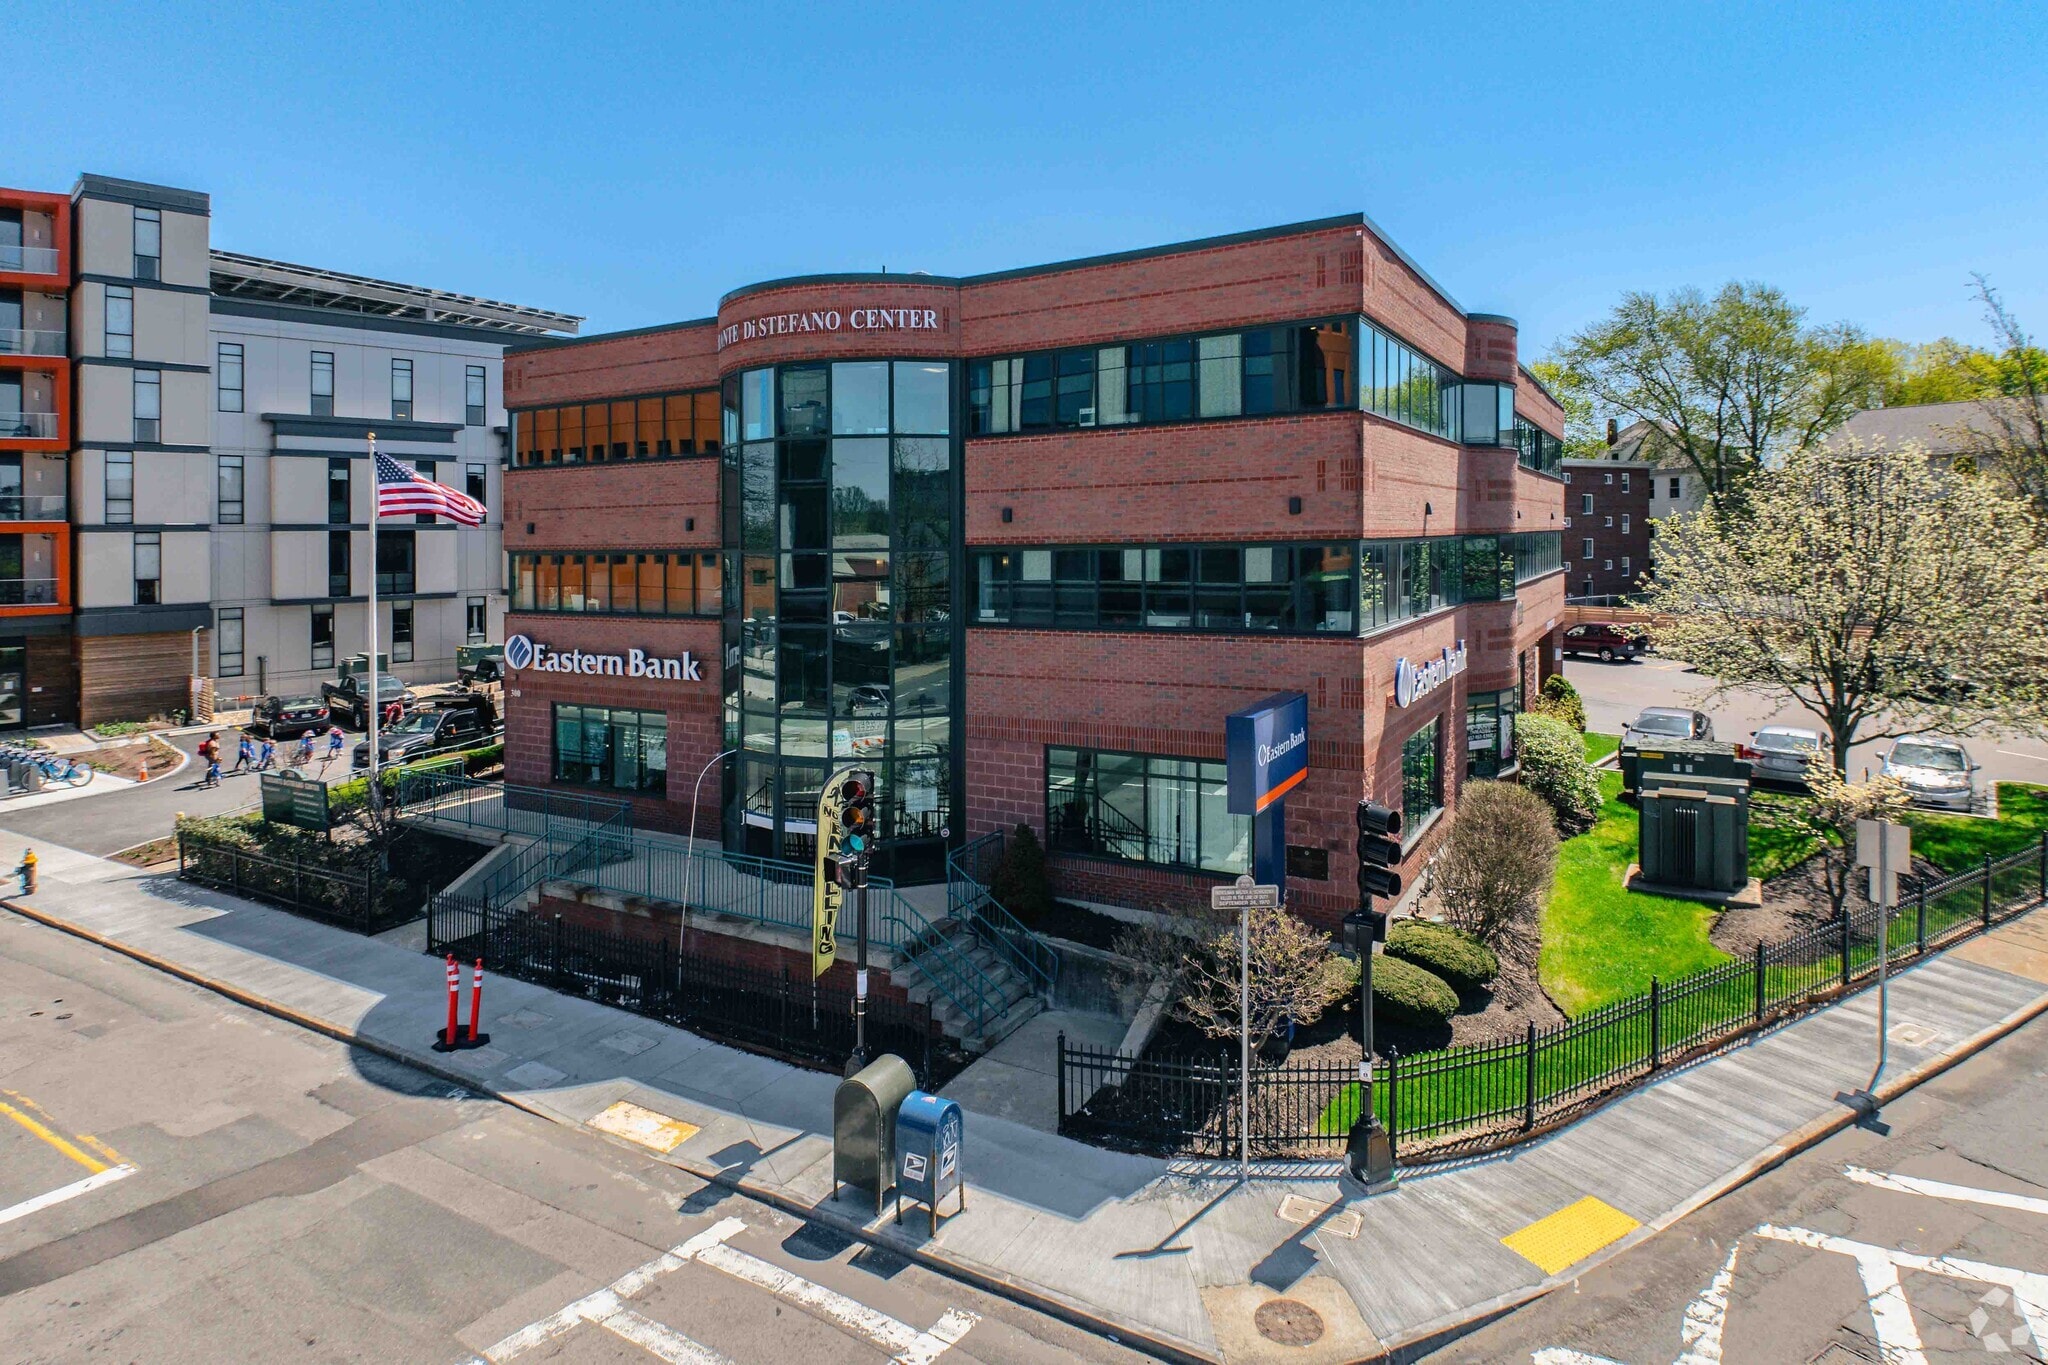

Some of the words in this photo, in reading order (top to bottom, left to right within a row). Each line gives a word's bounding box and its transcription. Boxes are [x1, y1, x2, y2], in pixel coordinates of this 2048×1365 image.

[850, 309, 938, 329] CENTER
[533, 643, 624, 676] Eastern
[628, 648, 702, 681] Bank
[1266, 739, 1290, 763] Eastern
[1290, 726, 1306, 750] Bank
